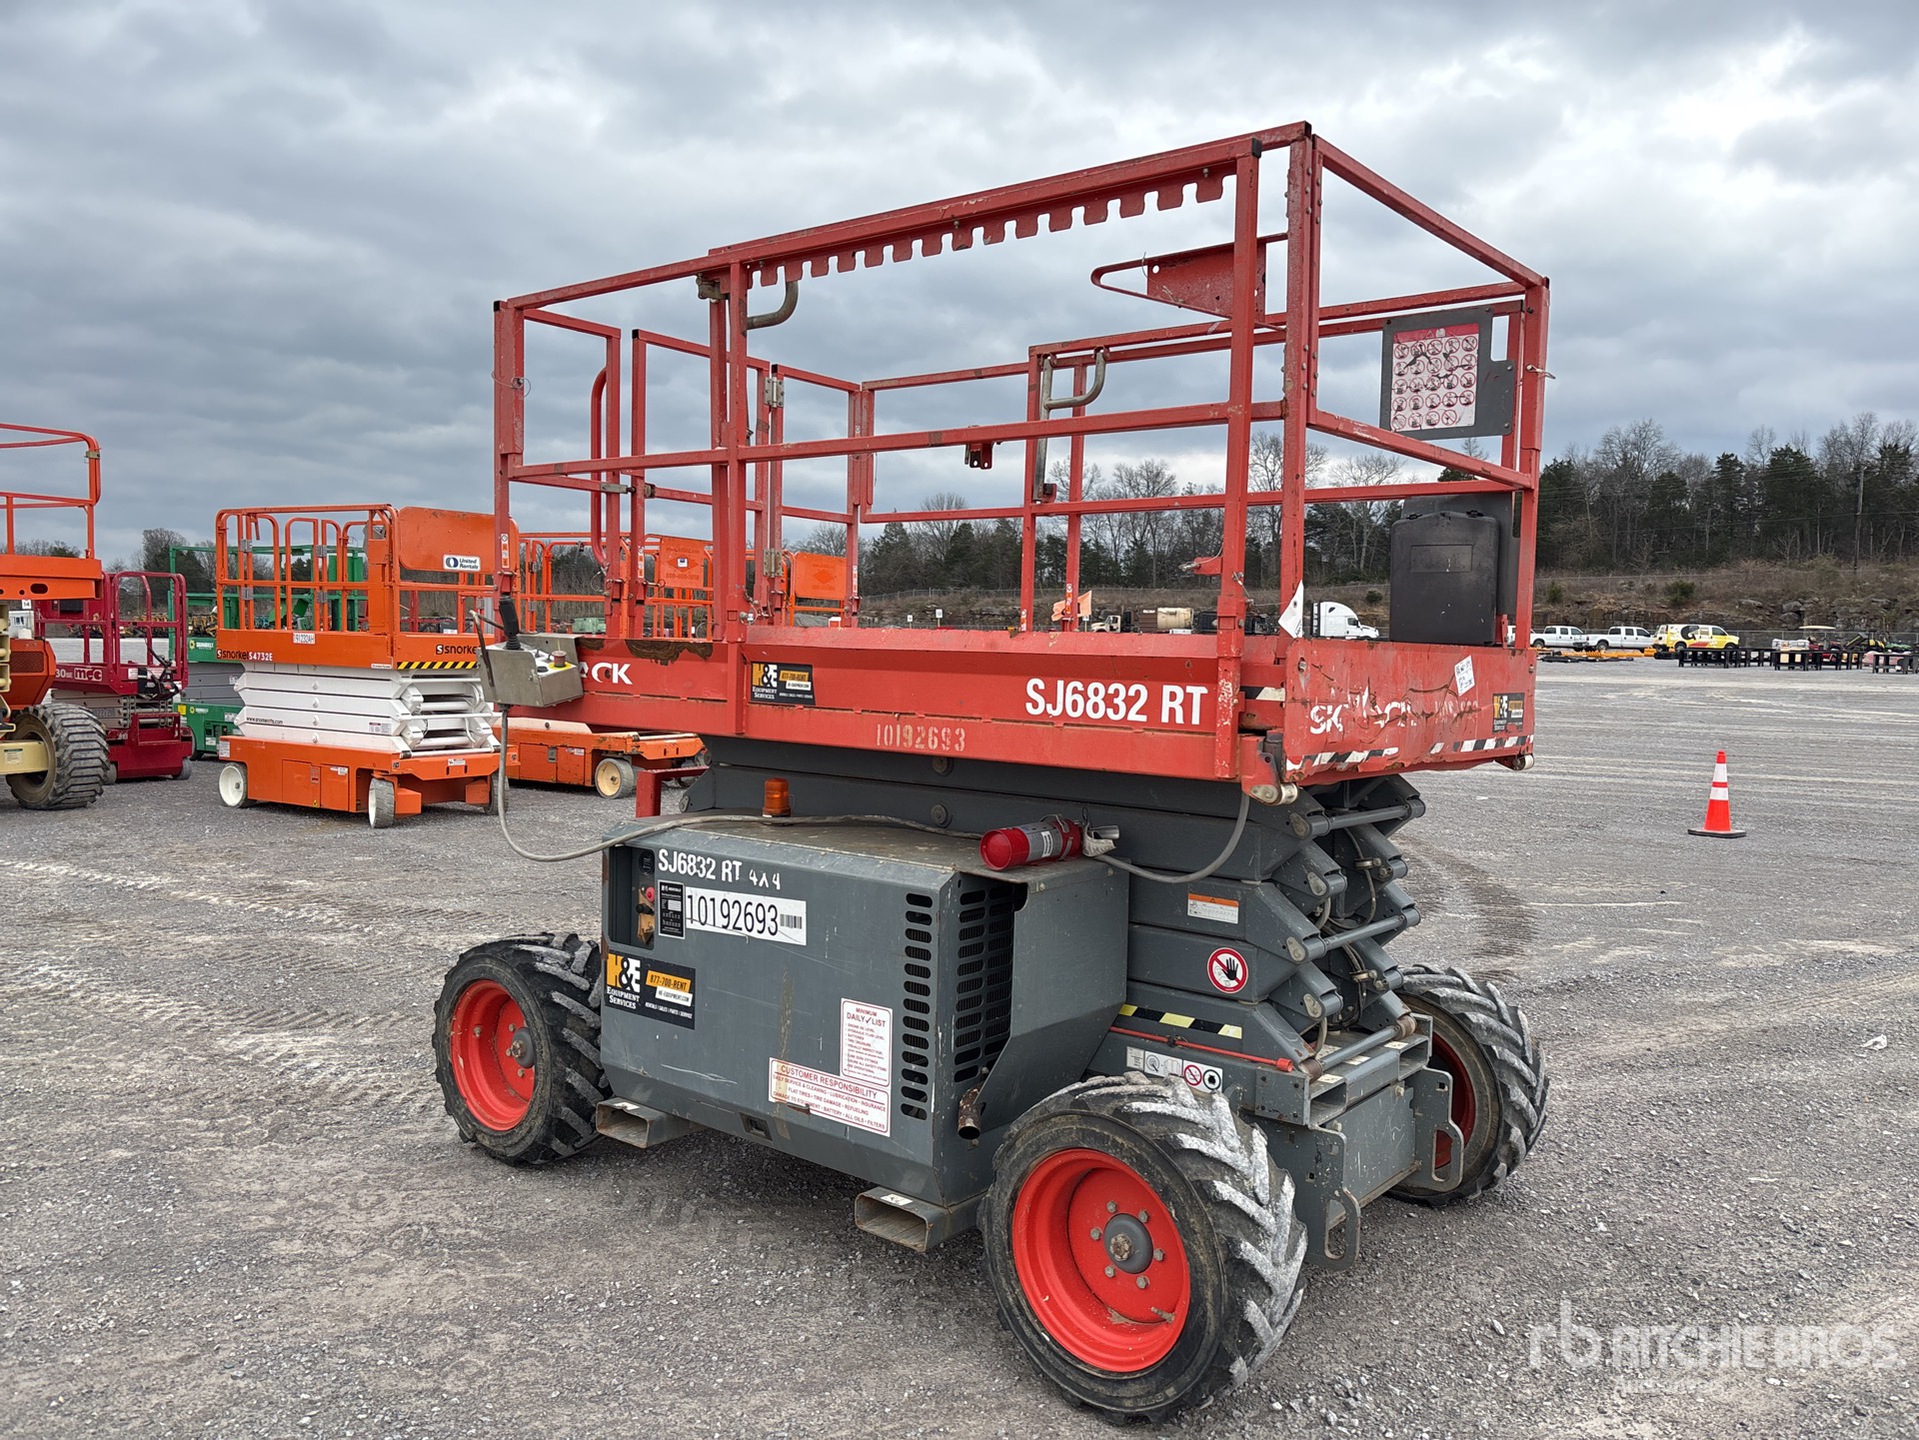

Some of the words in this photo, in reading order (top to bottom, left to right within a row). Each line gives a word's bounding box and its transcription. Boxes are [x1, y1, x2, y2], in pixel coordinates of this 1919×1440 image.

[248, 651, 273, 661] S4732E
[444, 645, 477, 655] snorke
[753, 663, 778, 687] H&E
[1025, 678, 1148, 722] SJ6832
[1161, 684, 1208, 725] RT
[876, 724, 966, 751] 10192693
[658, 848, 716, 880] SJ6832
[721, 860, 743, 883] RT
[687, 895, 779, 936] 10192693
[607, 953, 640, 993] H&E
[649, 973, 688, 991] 877-700-RENT
[606, 985, 640, 1002] EQUIPMENT
[609, 994, 637, 1010] SERVICES
[846, 1012, 865, 1022] DAILY
[871, 1018, 885, 1027] LIST
[855, 1007, 876, 1016] MINIMUM
[780, 1065, 818, 1082] CUSTOMER
[820, 1076, 877, 1099] RESPONSIBILITY
